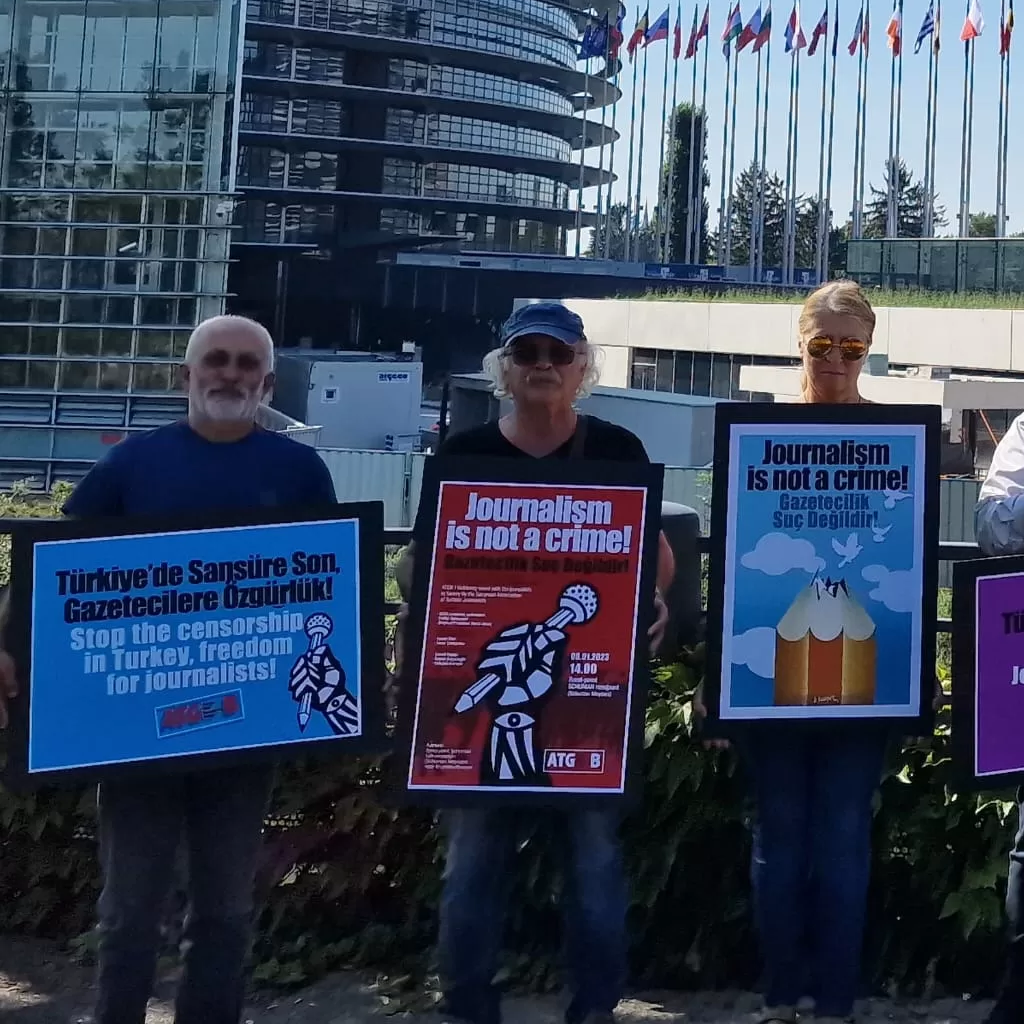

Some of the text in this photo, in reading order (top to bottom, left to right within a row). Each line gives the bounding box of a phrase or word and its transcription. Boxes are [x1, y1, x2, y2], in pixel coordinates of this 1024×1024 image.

[762, 439, 890, 465] Journalism
[747, 465, 908, 491] is not a crime!
[465, 492, 612, 524] Journalism
[780, 493, 870, 510] Gazetecilik
[445, 520, 632, 554] is not a crime!
[773, 510, 878, 532] Suç Değildir!
[56, 550, 340, 596] Türkiye'de Sansüre Son,
[64, 577, 333, 624] Gazetecilere Özgürlük!
[70, 610, 304, 651] Stop the censorship
[84, 634, 293, 674] in Turkey, freedom
[570, 662, 597, 674] 14.00
[106, 656, 276, 695] for journalists!
[547, 752, 601, 768] ATG B
